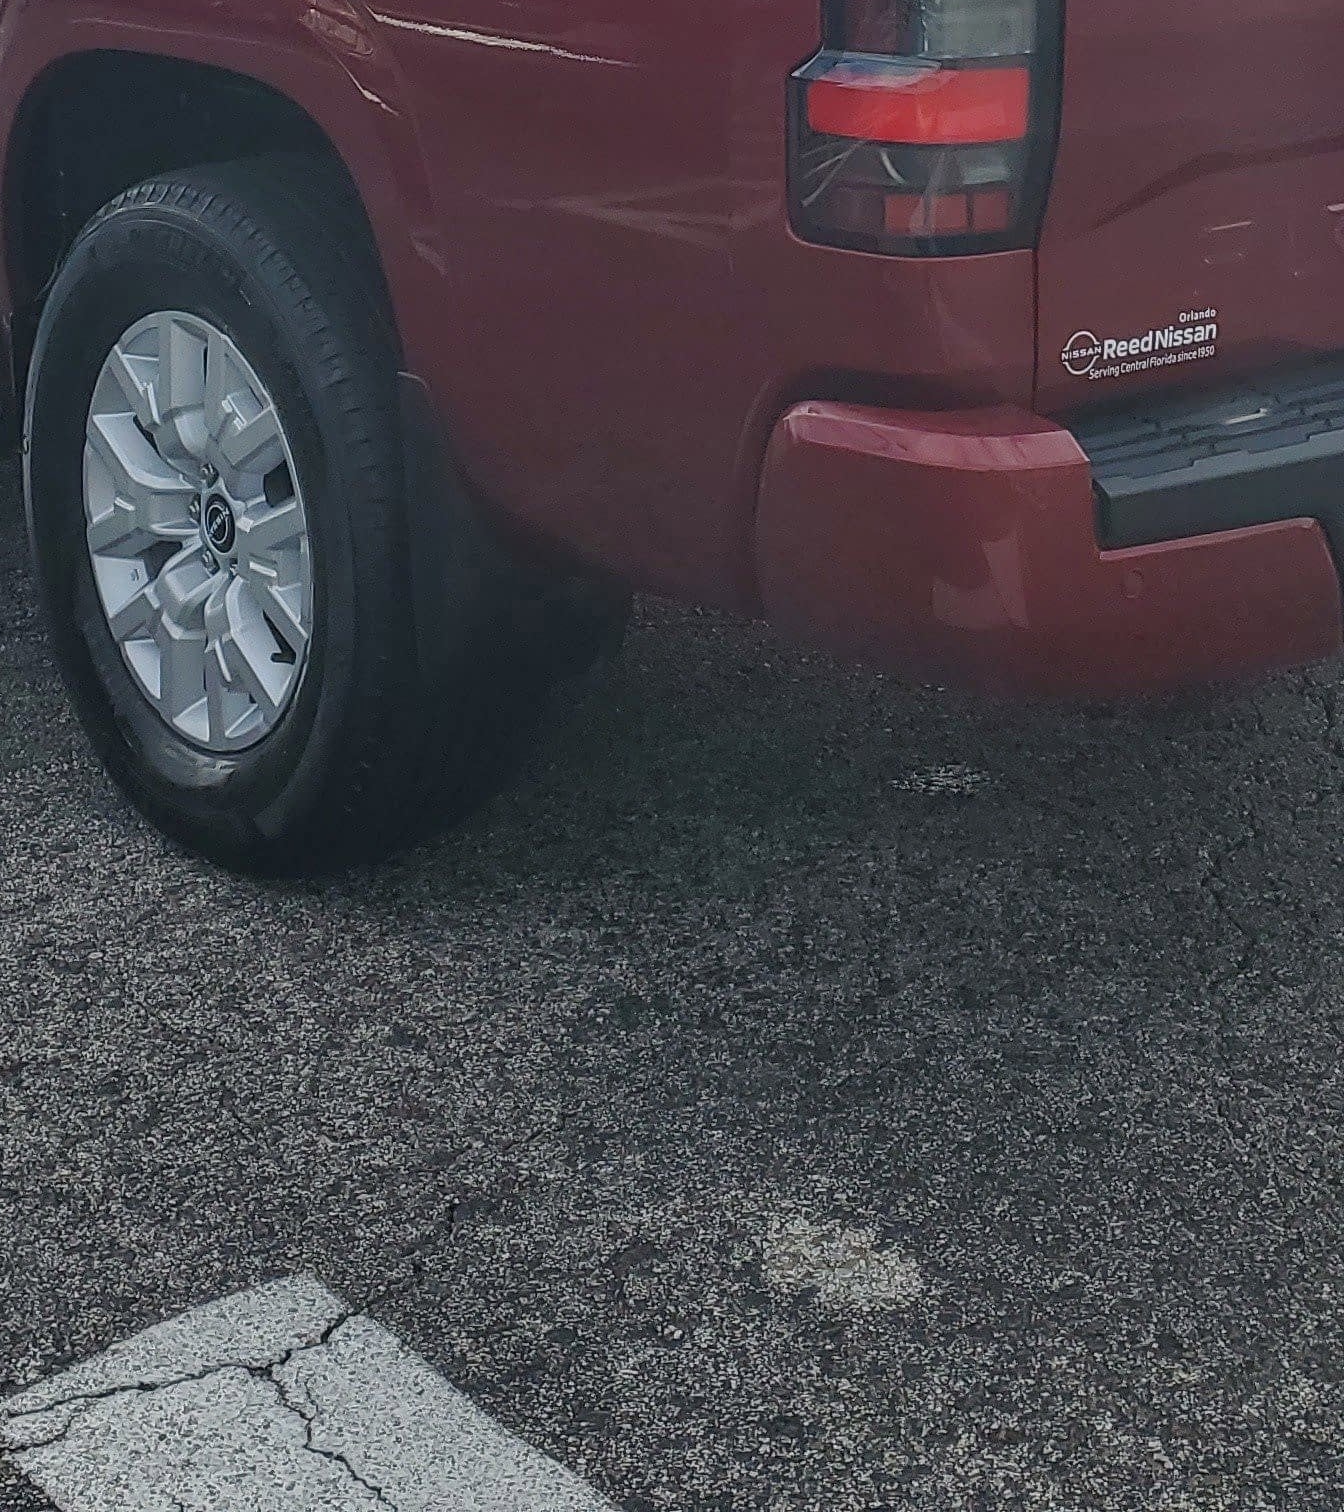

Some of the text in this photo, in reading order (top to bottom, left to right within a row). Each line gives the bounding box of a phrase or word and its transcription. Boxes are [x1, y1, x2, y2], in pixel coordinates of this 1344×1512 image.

[1178, 306, 1217, 323] Orlando
[1061, 344, 1102, 362] NISSAN
[1087, 362, 1120, 380] Serving
[1120, 357, 1149, 374] Central
[1150, 352, 1177, 369] Florida
[1177, 349, 1198, 363] since
